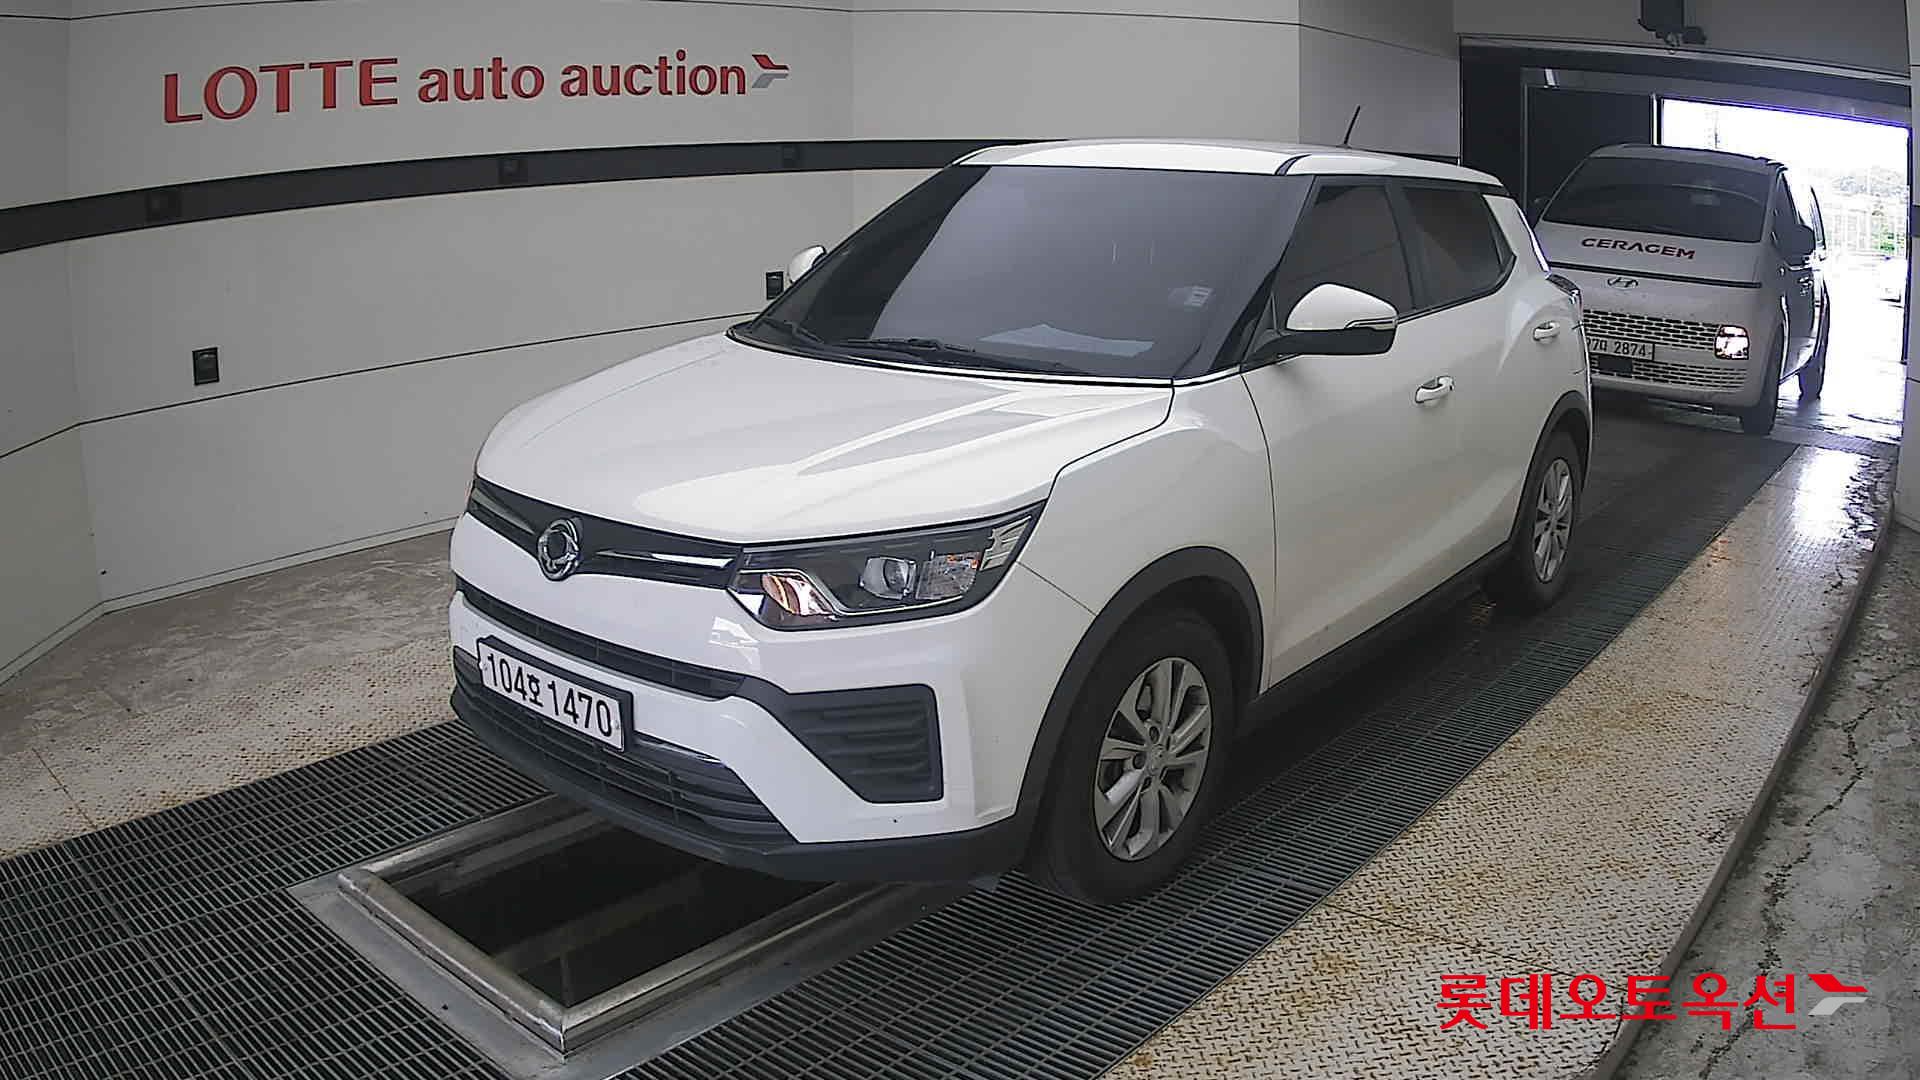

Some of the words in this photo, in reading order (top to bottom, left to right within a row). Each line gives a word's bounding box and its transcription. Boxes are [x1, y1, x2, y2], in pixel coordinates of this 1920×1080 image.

[164, 57, 398, 124] LOTTE
[418, 56, 545, 103] auto
[560, 50, 747, 97] auction
[1581, 238, 1696, 260] CERAGEM
[1614, 341, 1646, 356] 2874
